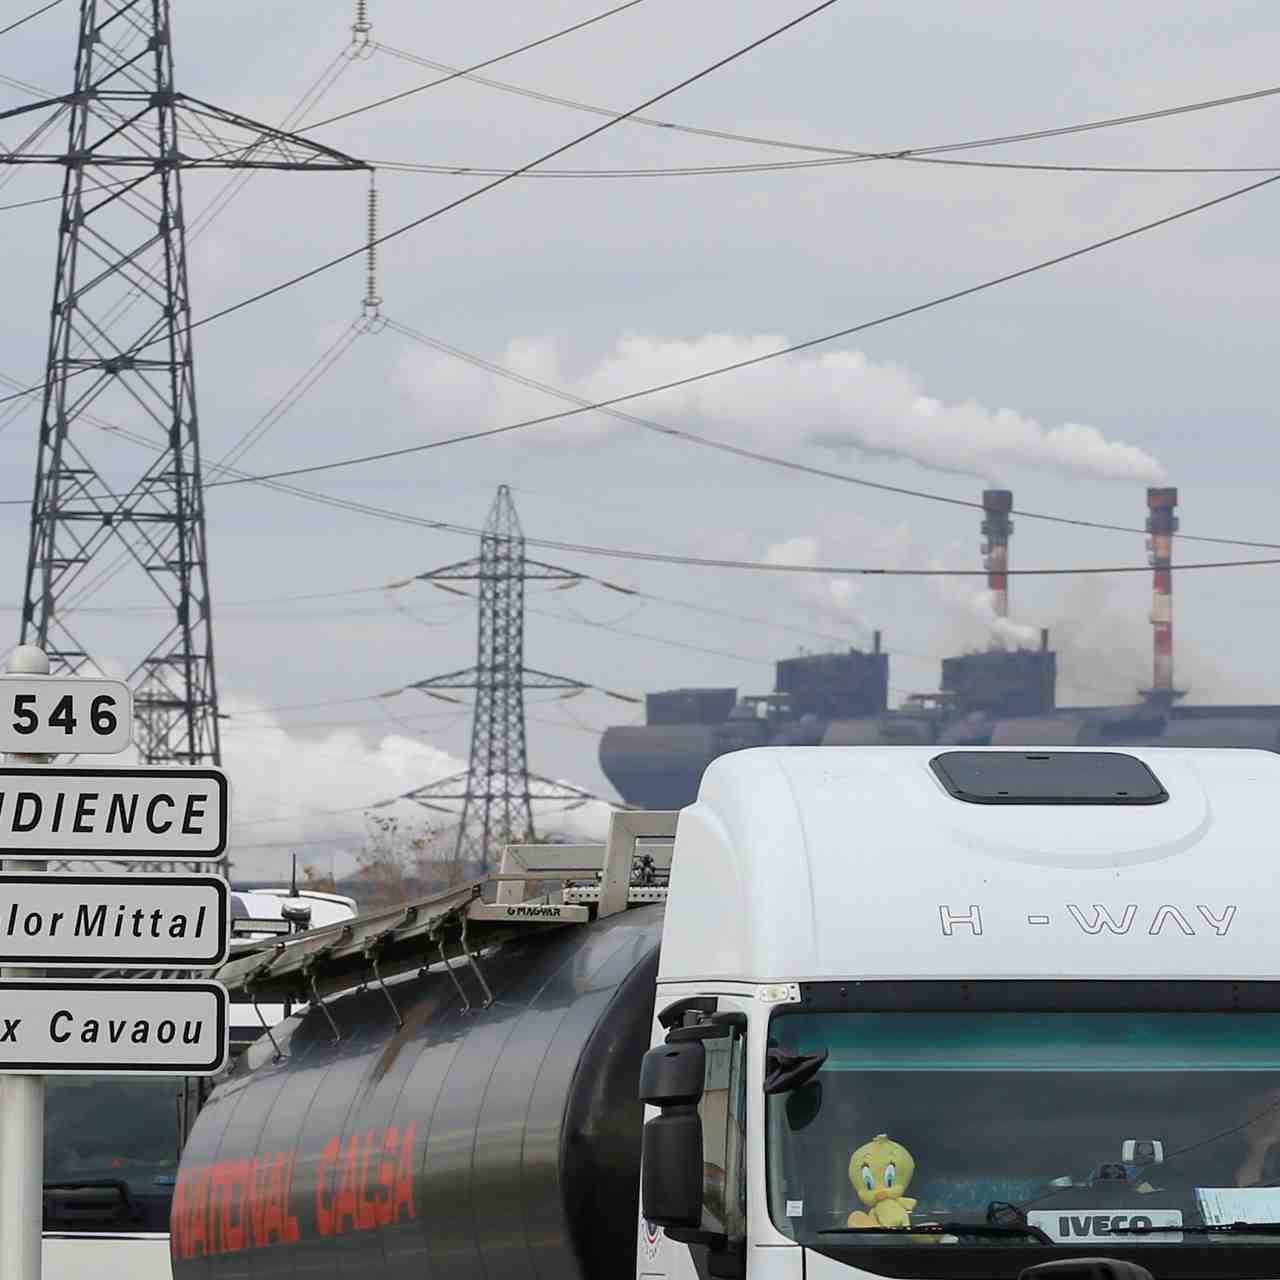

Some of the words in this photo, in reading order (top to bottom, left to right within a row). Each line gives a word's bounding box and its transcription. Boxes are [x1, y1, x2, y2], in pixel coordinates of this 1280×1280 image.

[12, 694, 117, 736] 546
[49, 1010, 203, 1045] Cavaou
[316, 1120, 417, 1236] CALSA
[1058, 1215, 1153, 1238] IVECO
